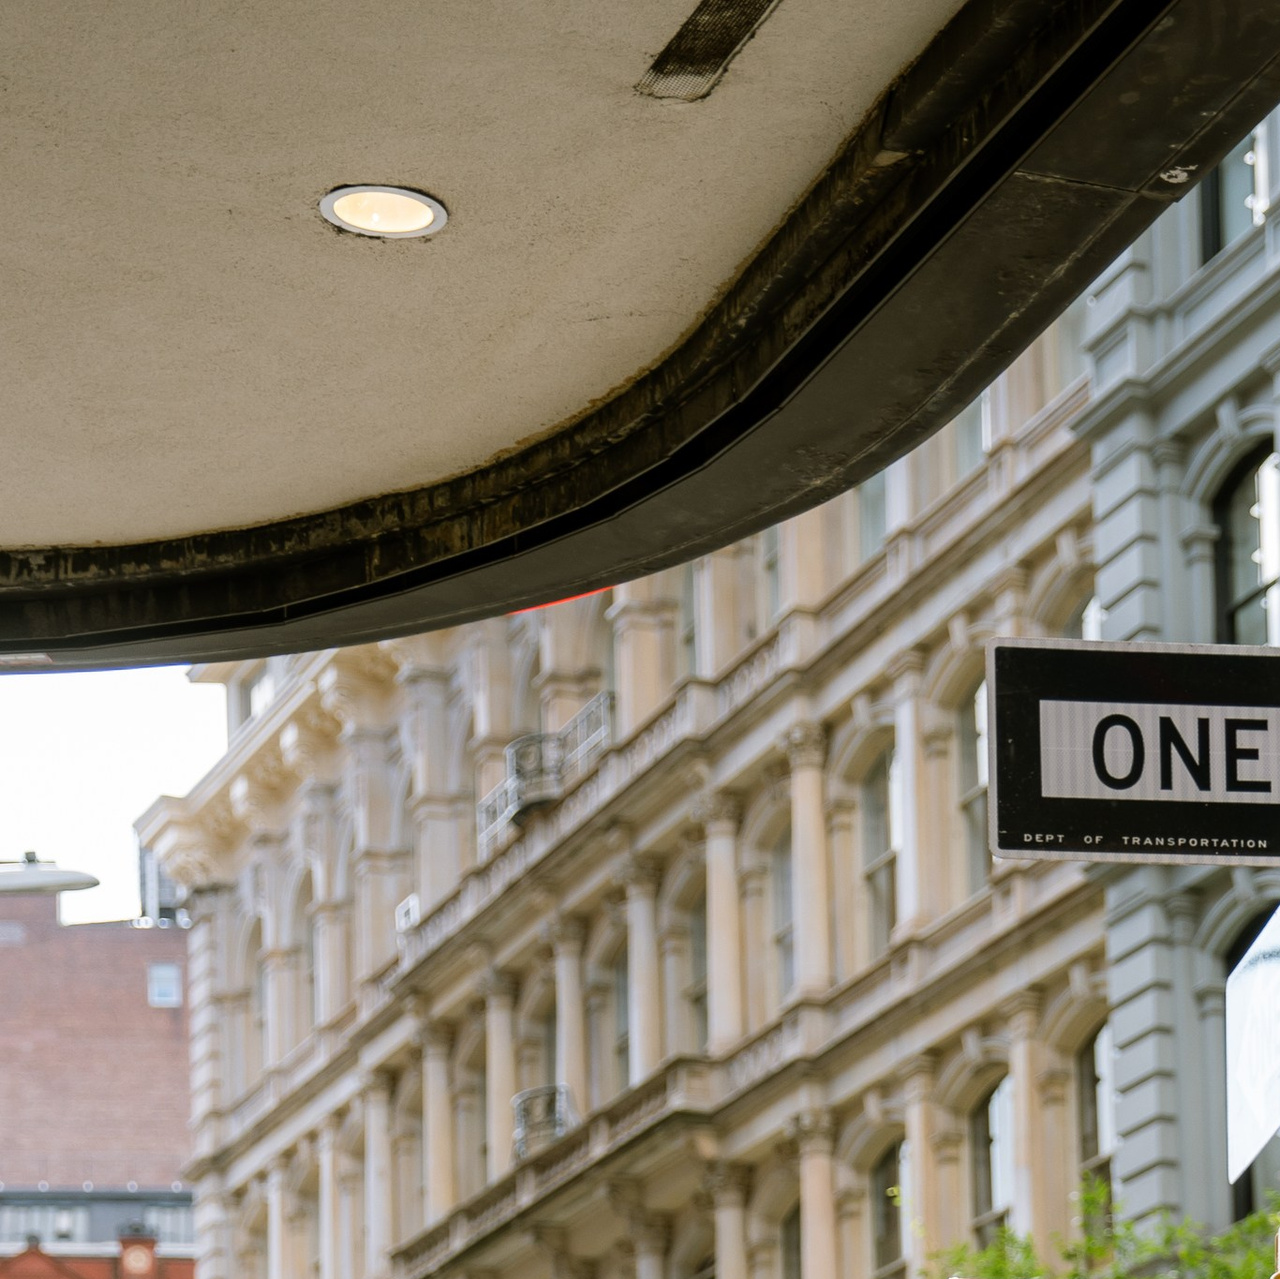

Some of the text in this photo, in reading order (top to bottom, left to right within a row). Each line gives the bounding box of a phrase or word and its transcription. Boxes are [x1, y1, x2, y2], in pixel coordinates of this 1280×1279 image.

[1092, 714, 1271, 793] ONE
[1023, 833, 1268, 849] DEPT OF TRANSPORTATION
